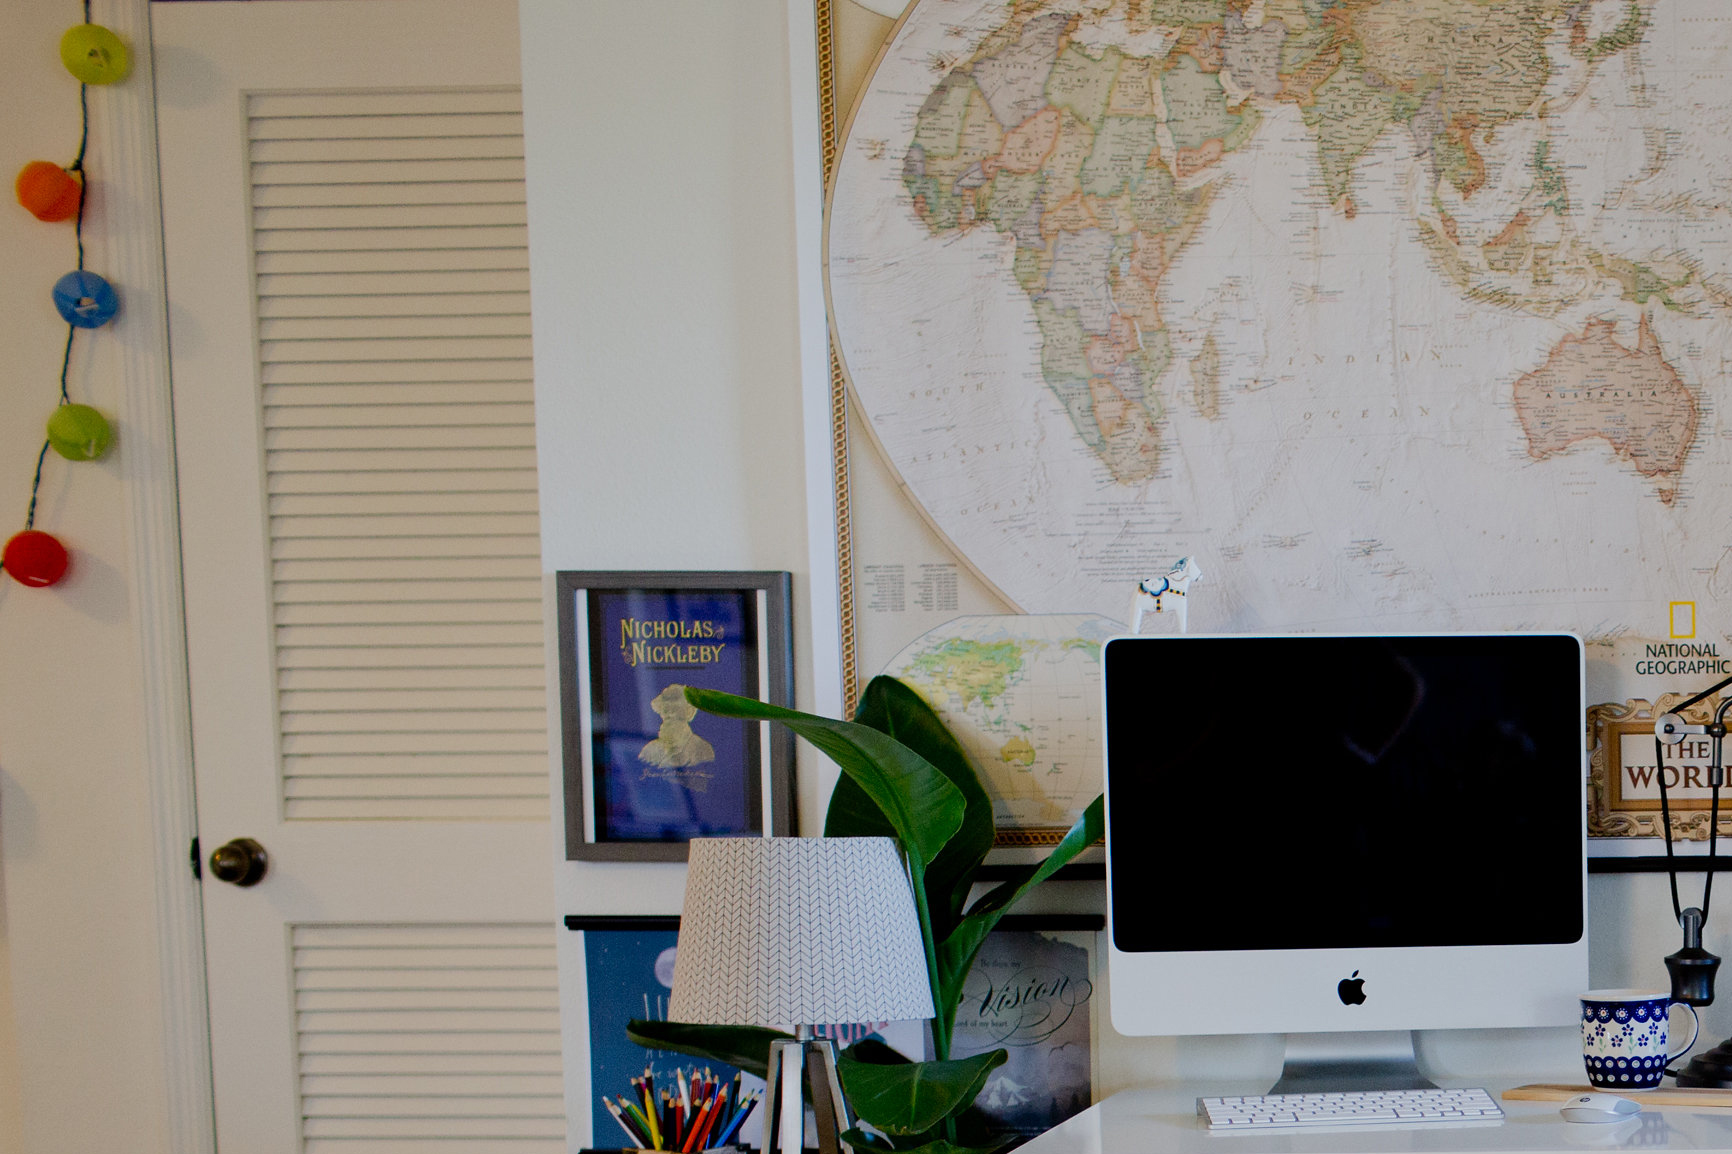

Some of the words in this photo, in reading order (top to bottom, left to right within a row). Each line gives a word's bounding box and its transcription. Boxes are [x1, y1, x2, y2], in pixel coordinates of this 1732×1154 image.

[1288, 349, 1440, 366] INDIAN
[1546, 391, 1658, 399] AUSTRALIA
[1302, 404, 1431, 420] OCEAN
[620, 618, 713, 649] NICHOLAS
[631, 640, 726, 667] NICKLEBY
[1646, 643, 1720, 658] NATIONAL
[1635, 660, 1731, 675] GEOGRAPHIC
[1662, 741, 1711, 759] THE
